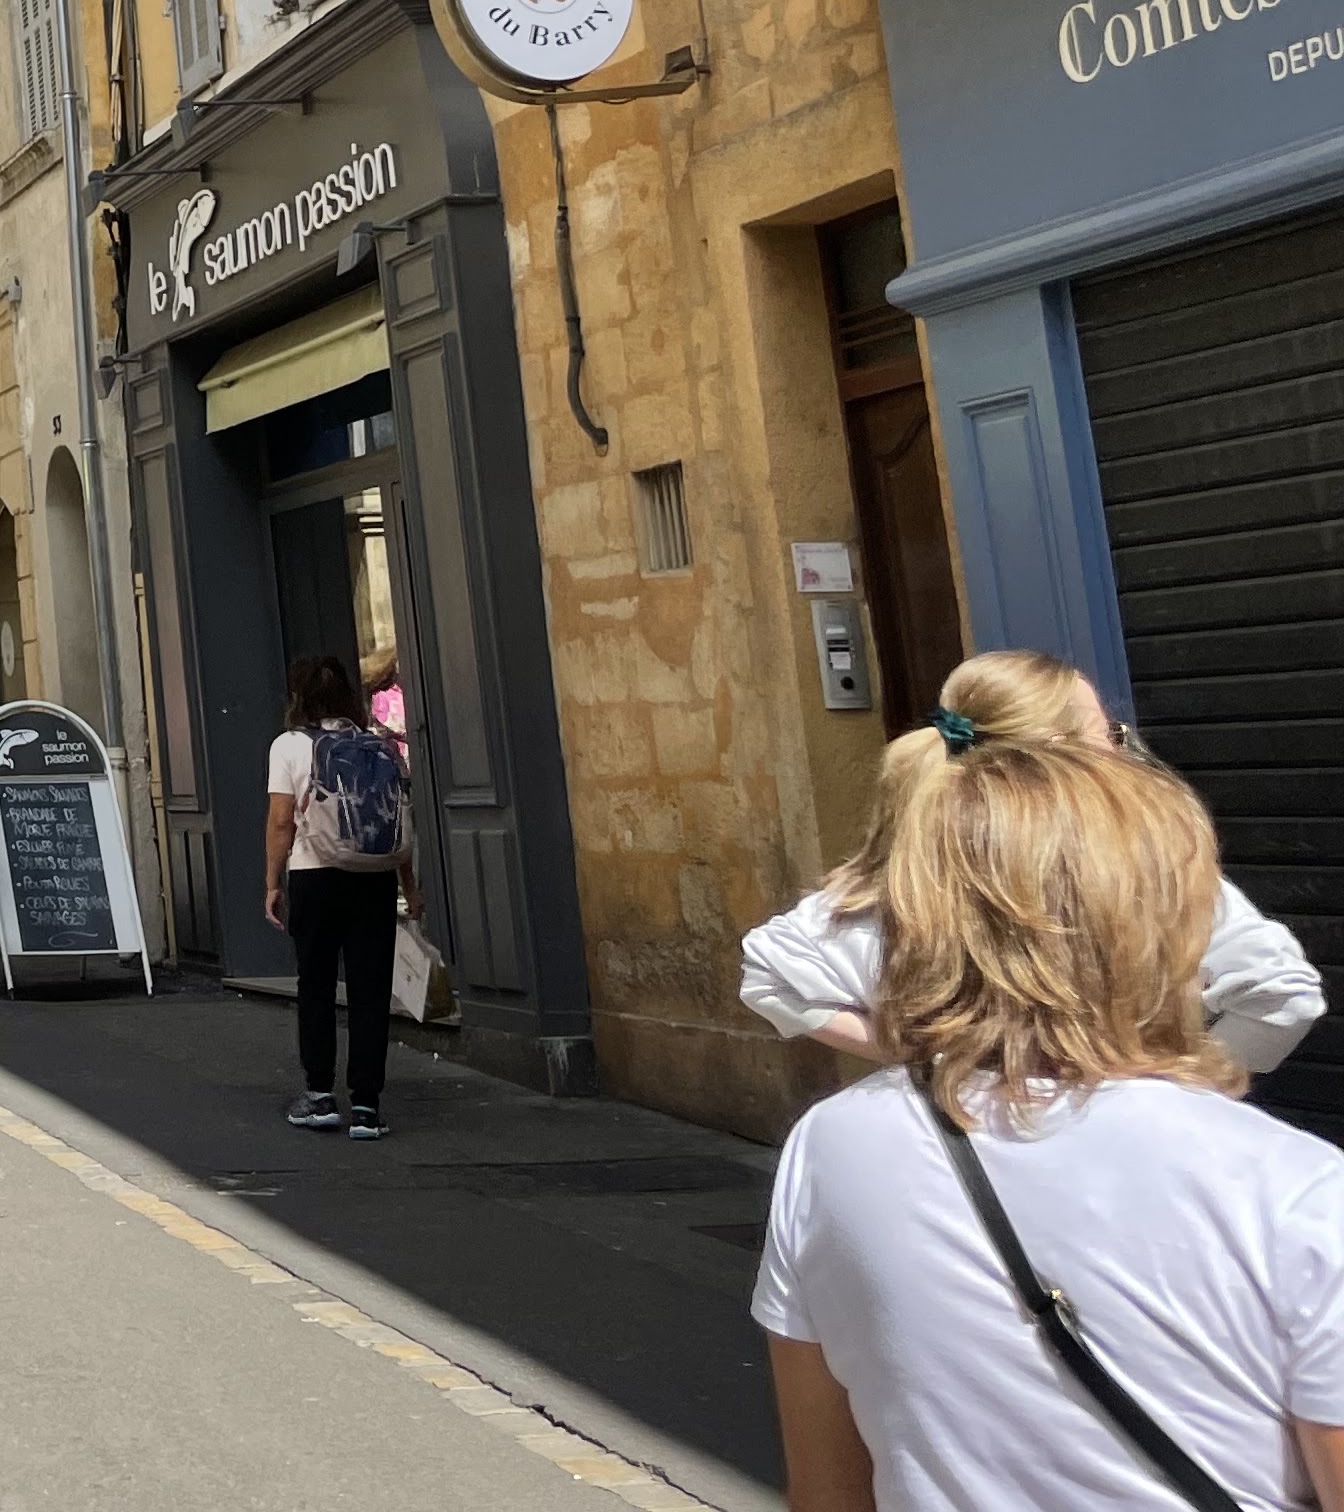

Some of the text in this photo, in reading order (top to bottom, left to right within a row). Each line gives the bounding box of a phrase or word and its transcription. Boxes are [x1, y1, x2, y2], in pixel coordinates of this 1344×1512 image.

[488, 1, 614, 47] du Barry
[148, 142, 397, 315] le saumon passion
[56, 729, 68, 741] le
[41, 742, 87, 753] saumon
[44, 752, 90, 766] passion
[63, 807, 78, 821] DE
